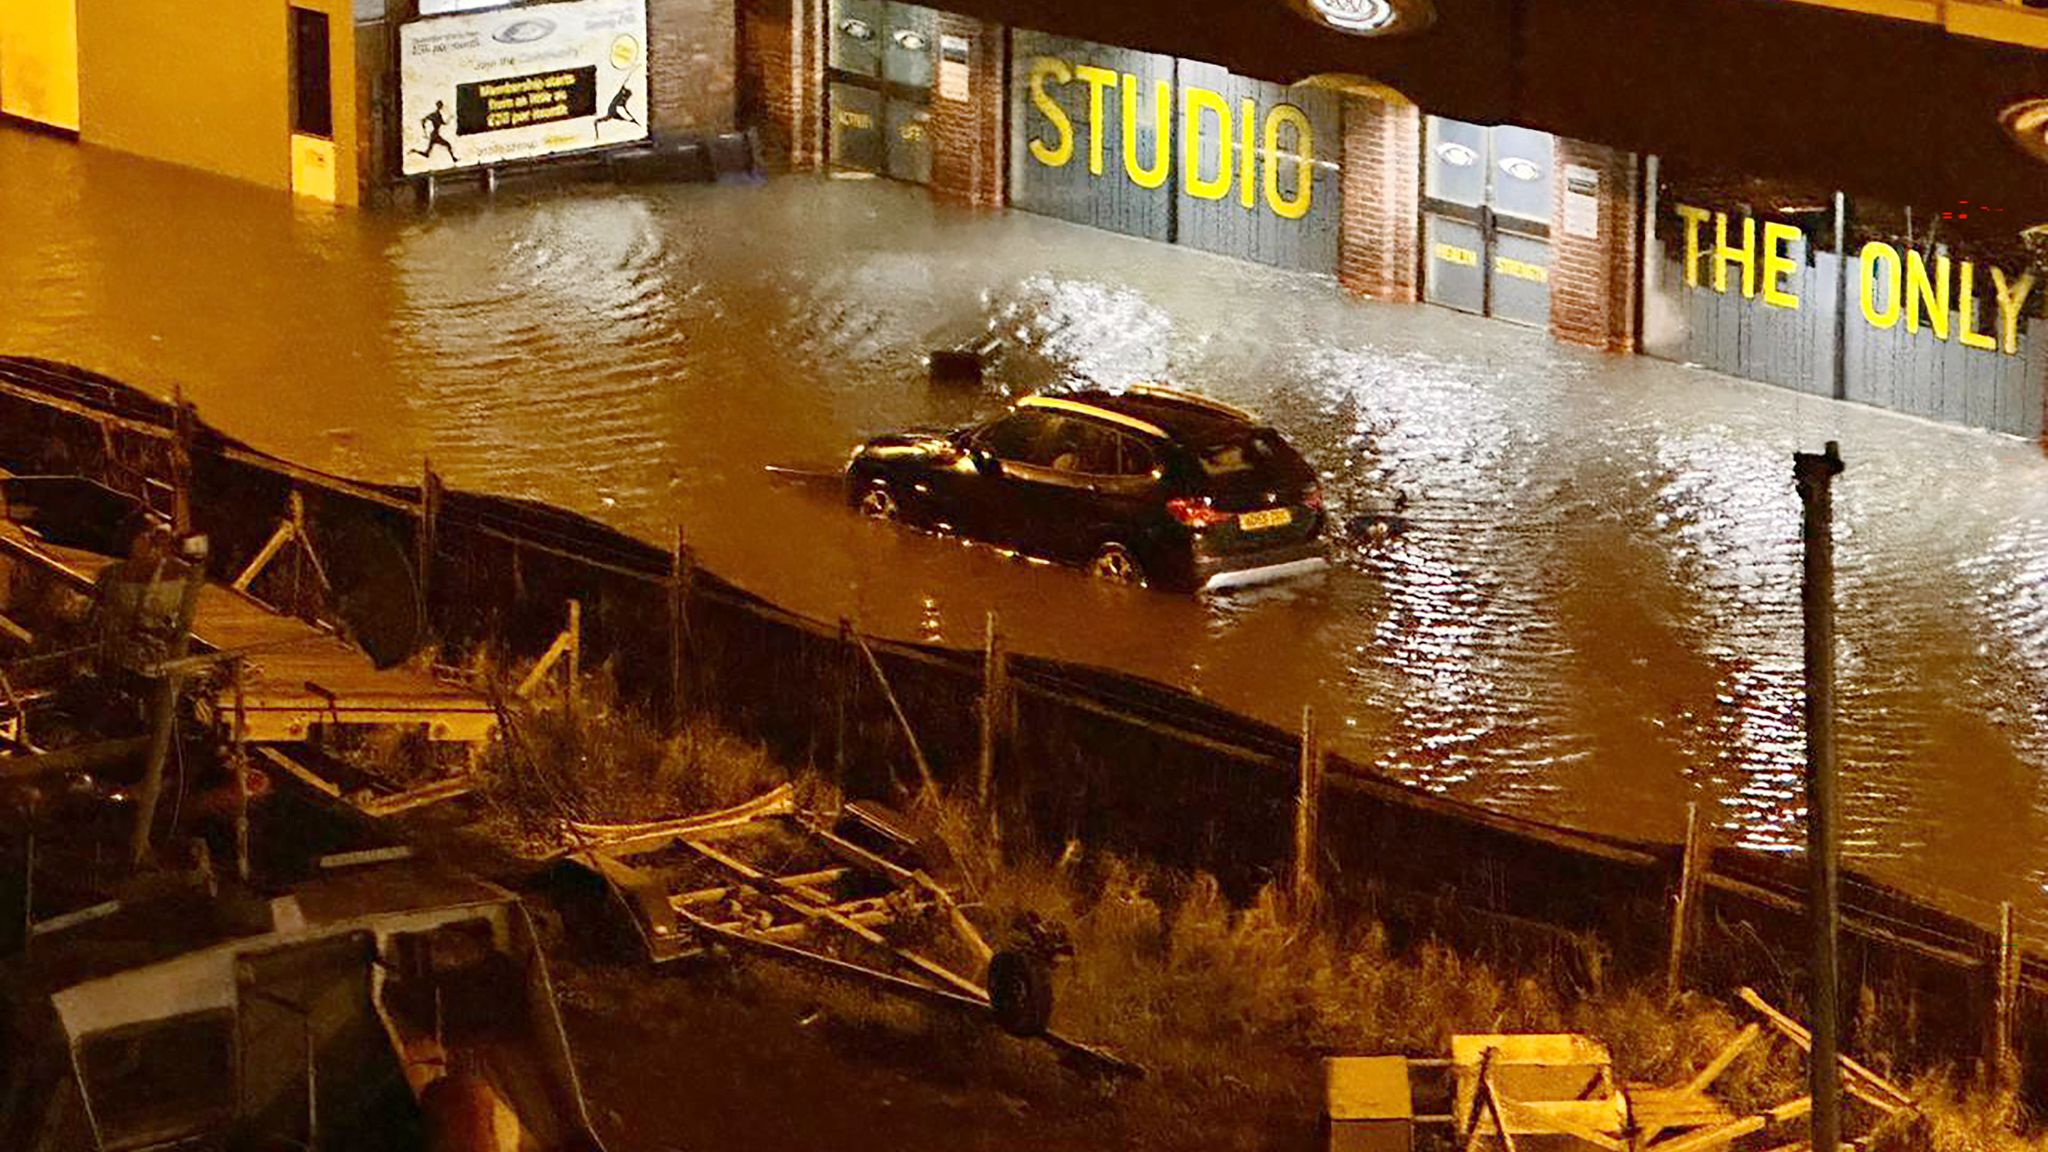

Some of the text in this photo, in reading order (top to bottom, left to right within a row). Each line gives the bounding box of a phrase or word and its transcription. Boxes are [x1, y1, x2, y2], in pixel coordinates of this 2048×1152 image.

[1029, 55, 1313, 219] STUDIO
[1674, 204, 2036, 355] THE ONLY
